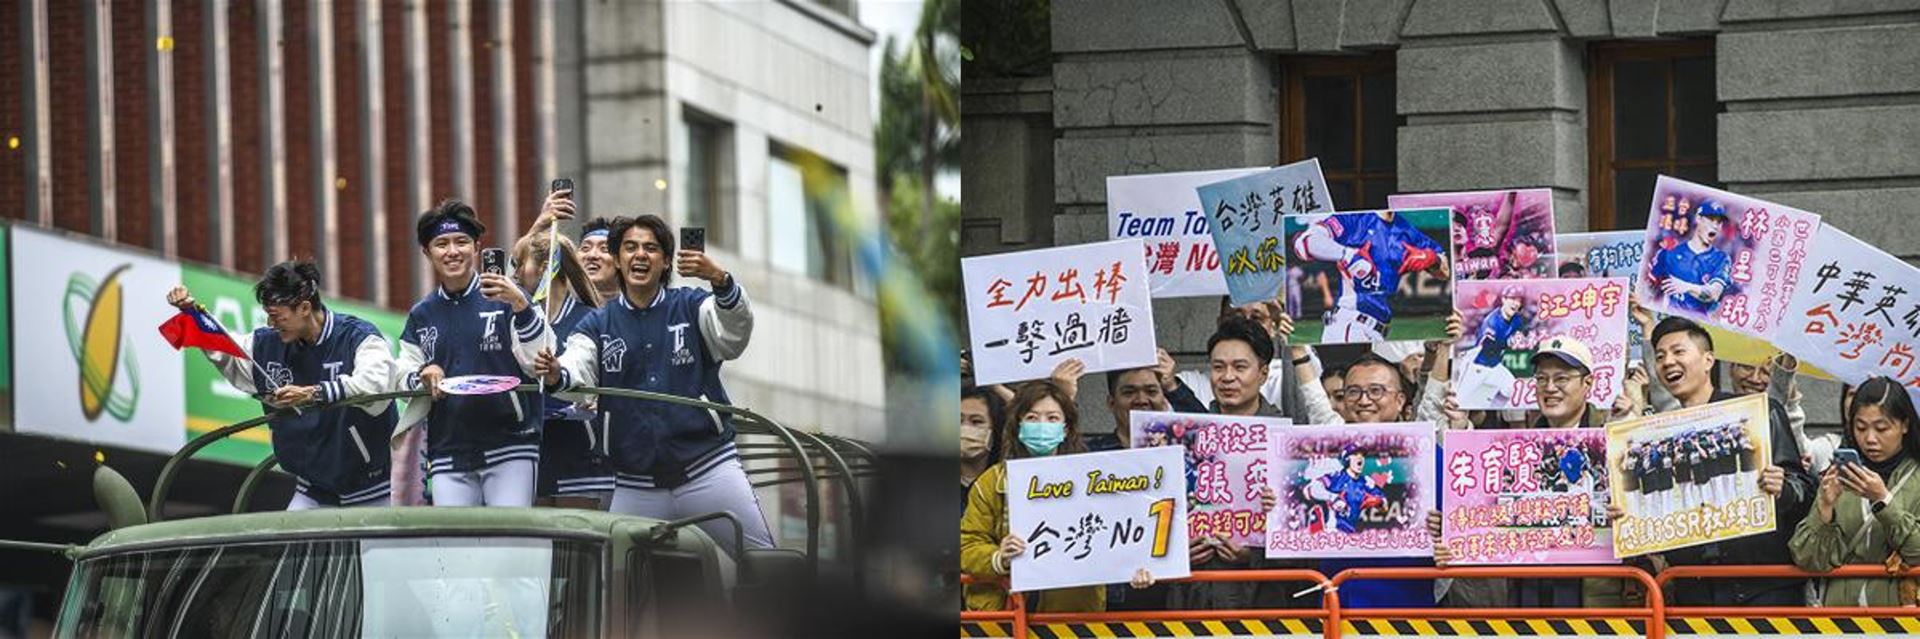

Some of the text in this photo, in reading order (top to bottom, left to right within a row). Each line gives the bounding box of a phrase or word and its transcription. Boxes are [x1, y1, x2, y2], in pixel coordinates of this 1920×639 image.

[1117, 210, 1212, 237] Team Ta
[1214, 180, 1321, 233] 台灣英雄
[1455, 256, 1499, 273] aiwan
[985, 261, 1128, 314] 全力出棒
[1538, 281, 1623, 321] 江坤宇
[984, 307, 1133, 365] 一擊過牆
[1197, 423, 1267, 456] 勝投王
[1027, 475, 1073, 500] Love
[1449, 441, 1541, 497] 朱育賢
[1027, 513, 1108, 561] 台灣
[1110, 517, 1144, 549] No
